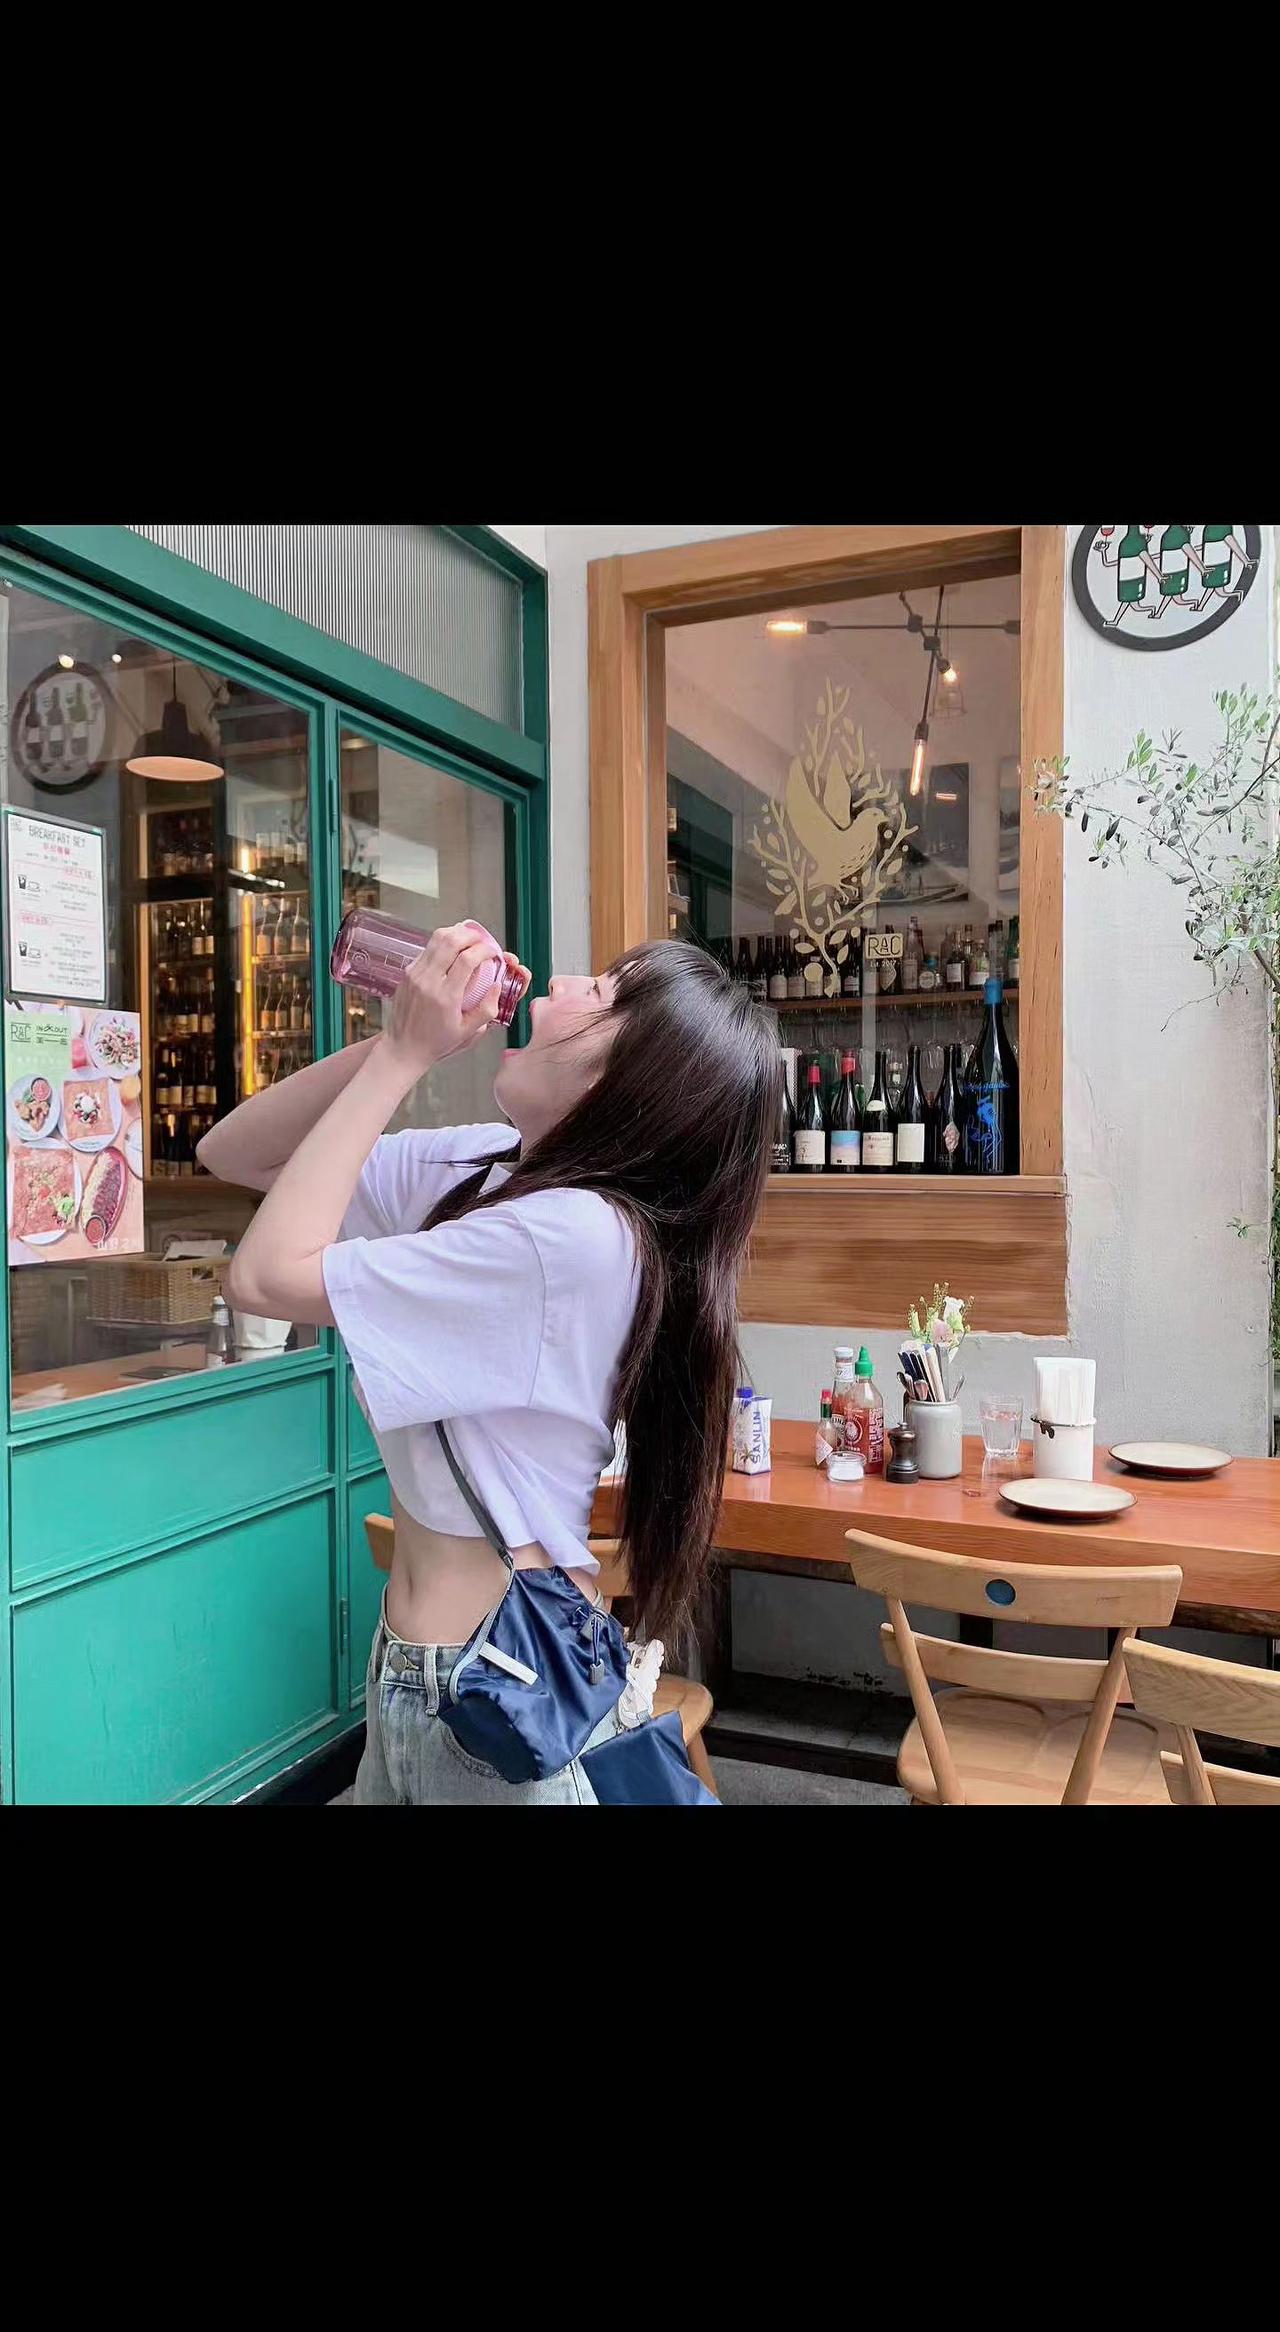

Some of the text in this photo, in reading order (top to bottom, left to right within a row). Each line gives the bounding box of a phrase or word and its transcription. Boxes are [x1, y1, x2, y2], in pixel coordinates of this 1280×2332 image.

[28, 825, 71, 845] BREAKFAST
[72, 835, 86, 848] SET
[868, 935, 902, 957] RAC
[10, 1023, 31, 1040] RAC
[752, 1411, 761, 1464] SANLIN
